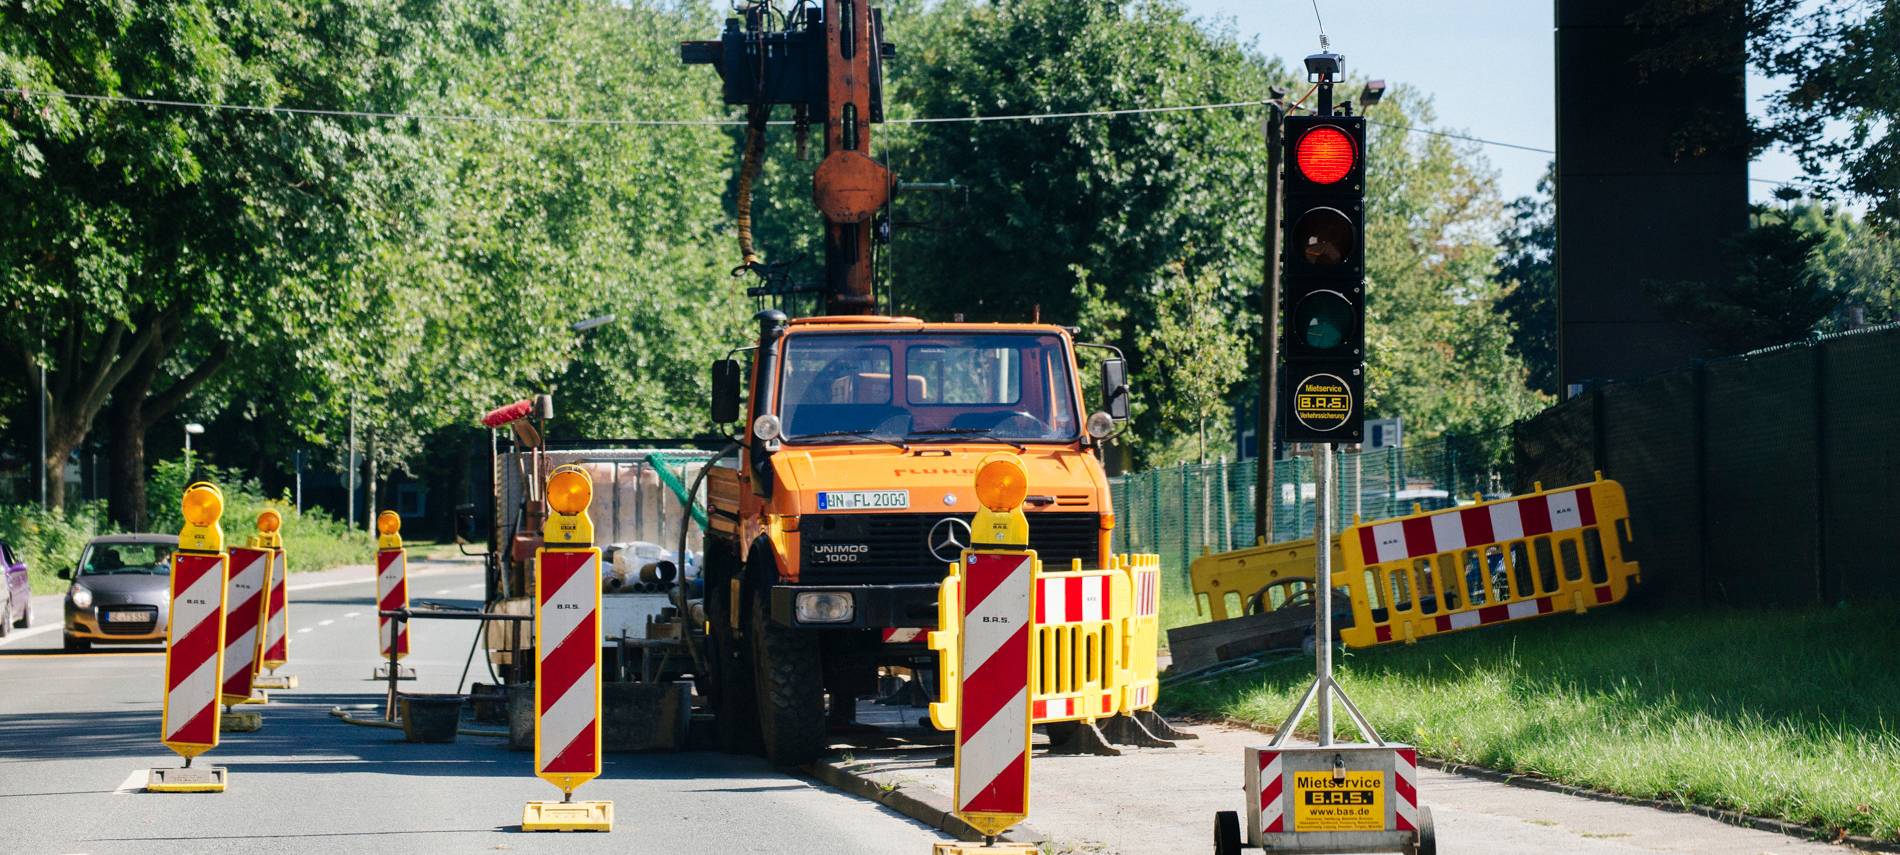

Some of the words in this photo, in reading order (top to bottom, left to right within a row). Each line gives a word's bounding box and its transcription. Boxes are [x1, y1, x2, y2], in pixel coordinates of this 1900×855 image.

[1301, 397, 1346, 408] B.A.S.
[854, 493, 870, 507] FL
[814, 545, 868, 553] UNIMOG
[825, 554, 857, 562] 1000
[982, 616, 1010, 624] B.A.S.
